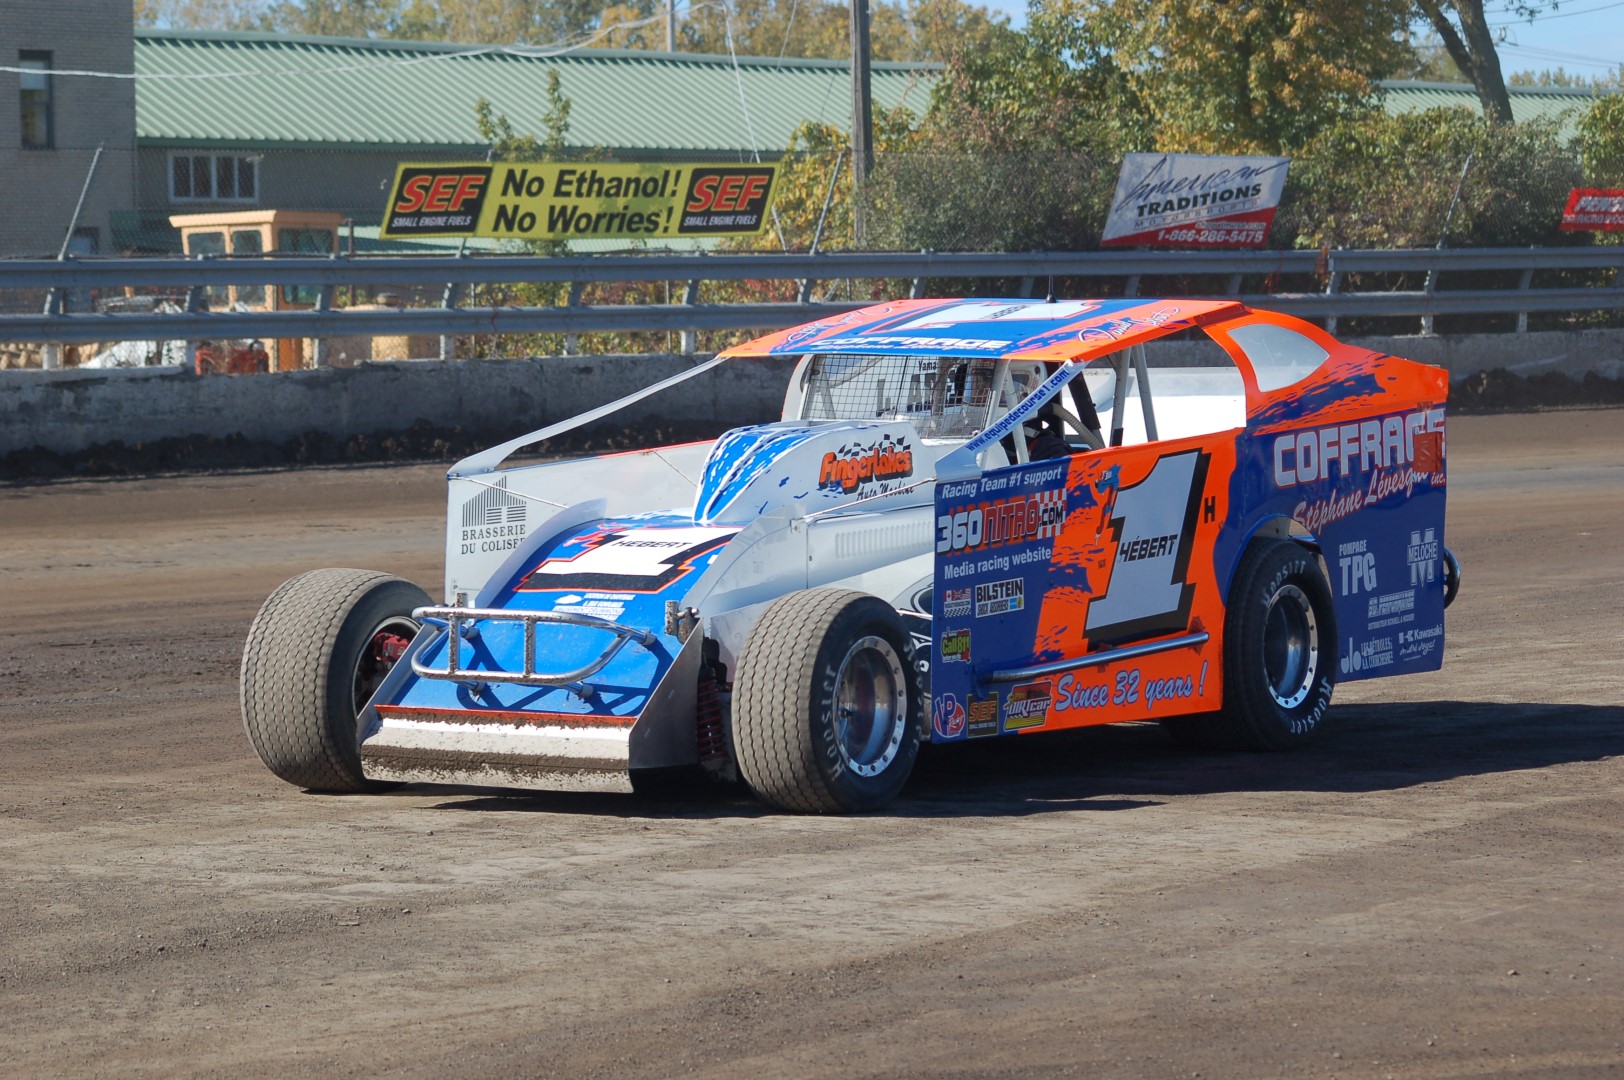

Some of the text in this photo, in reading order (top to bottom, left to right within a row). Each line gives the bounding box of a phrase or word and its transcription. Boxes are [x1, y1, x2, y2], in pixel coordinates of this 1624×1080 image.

[395, 175, 486, 213] SEF
[501, 169, 682, 199] No Ethanol!
[686, 175, 769, 213] SEF
[1115, 155, 1292, 213] American
[1136, 184, 1261, 217] TRADITIONS
[392, 216, 472, 228] SMALL ENGINE FUELS
[492, 204, 674, 234] No Worries!
[684, 215, 757, 227] SMALL ENGINE FUELS
[965, 367, 1070, 452] www.equipedecourse1.com
[942, 466, 1062, 499] Racing Team #1 support
[1204, 496, 1216, 523] H
[462, 524, 526, 541] BRASSERIE
[1086, 450, 1199, 631] 1
[461, 542, 476, 554] DU
[1119, 534, 1178, 562] HÉBERT
[1339, 540, 1367, 556] POMPAGE
[1408, 542, 1437, 563] MELOCHE
[945, 547, 1051, 580] Media racing website
[1339, 552, 1377, 597] TPG
[977, 579, 1023, 603] BILSTEIN
[943, 637, 957, 654] Call
[1414, 624, 1442, 640] Kawasaki
[1055, 673, 1109, 712] Since
[1113, 668, 1140, 705] 32
[1144, 674, 1193, 710] years
[969, 701, 997, 723] SEF
